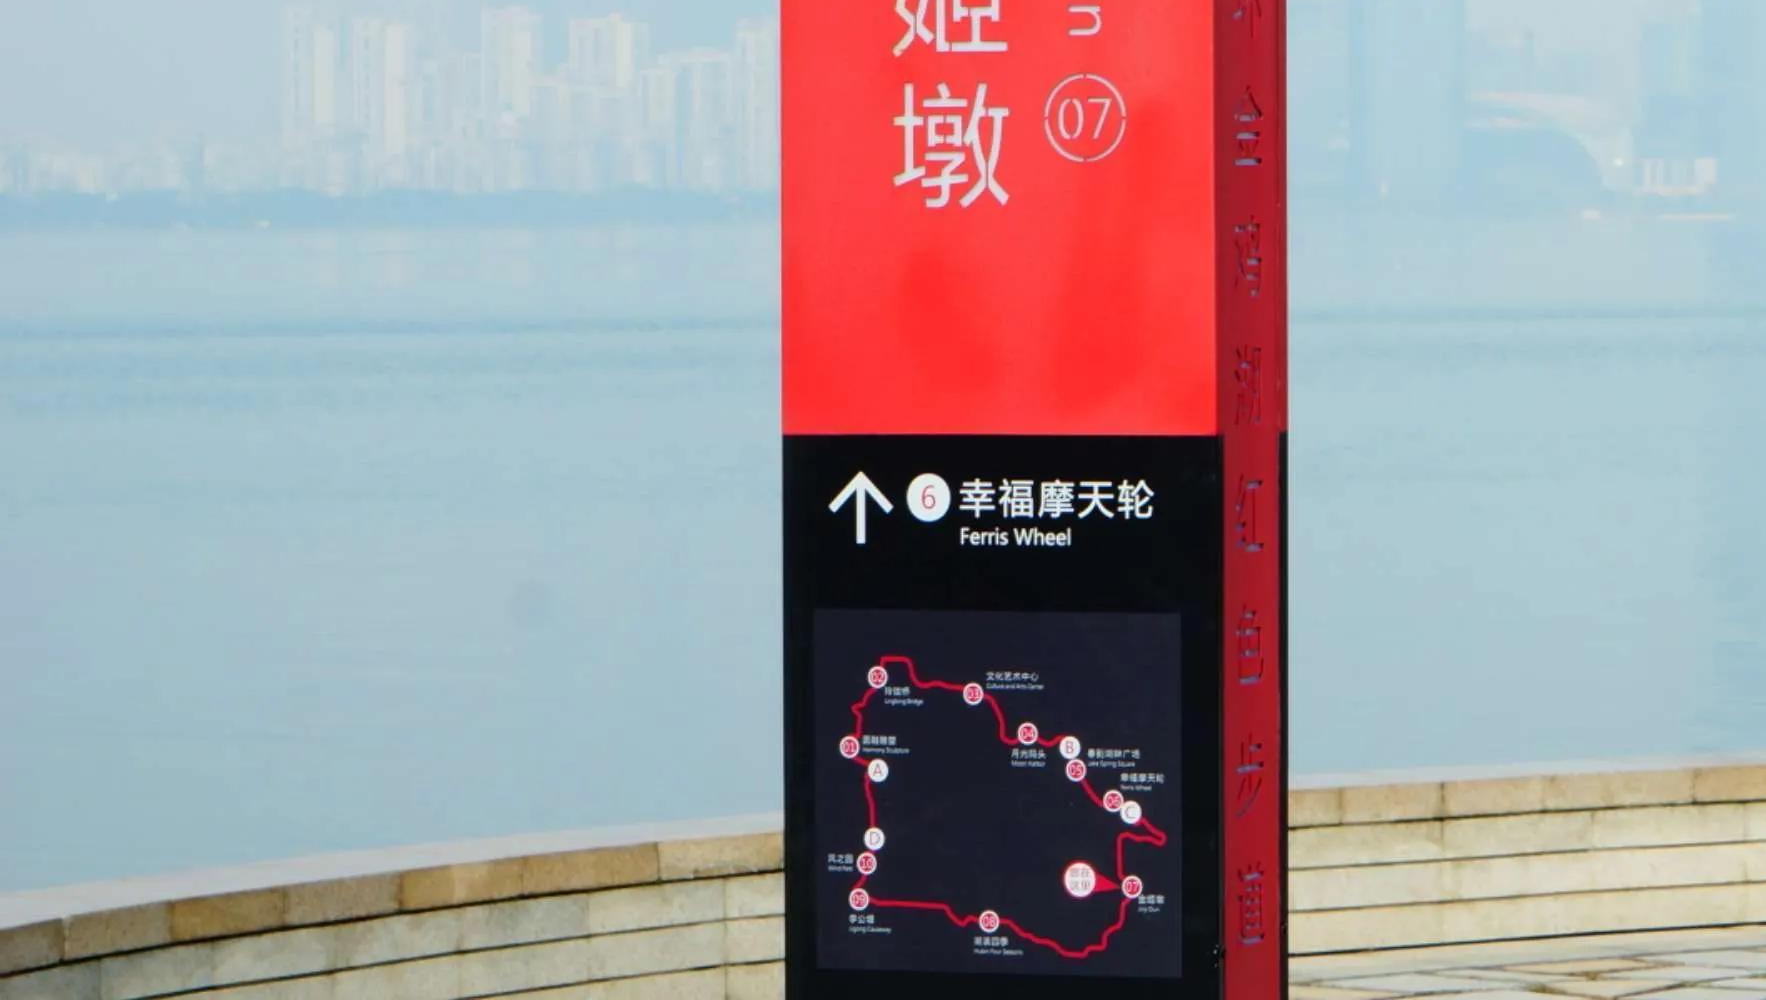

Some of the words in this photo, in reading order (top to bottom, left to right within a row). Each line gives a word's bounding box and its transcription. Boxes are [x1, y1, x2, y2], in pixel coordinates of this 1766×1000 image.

[1057, 97, 1113, 141] 07
[921, 484, 937, 510] 6
[959, 478, 1155, 520] 幸福摩天轮
[960, 527, 1010, 546] Ferris
[1013, 527, 1073, 546] Wheel
